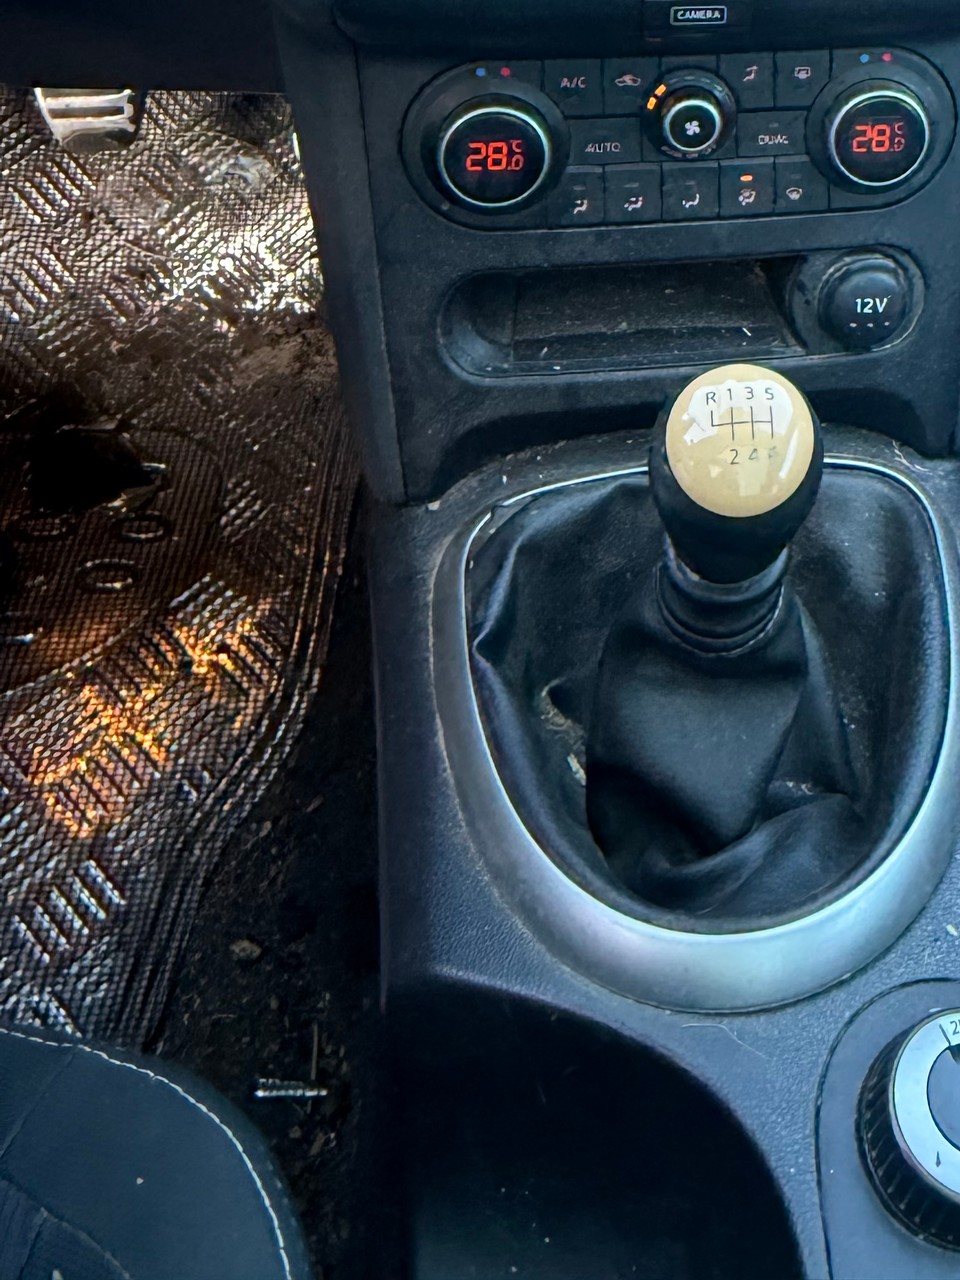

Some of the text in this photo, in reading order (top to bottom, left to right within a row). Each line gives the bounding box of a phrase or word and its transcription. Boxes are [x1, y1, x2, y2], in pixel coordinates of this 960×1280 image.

[676, 9, 721, 20] CAMERA
[560, 76, 587, 89] A/C
[584, 141, 621, 153] AUTO
[855, 296, 889, 315] 12V
[705, 391, 717, 405] R
[726, 387, 733, 401] 1
[744, 386, 755, 400] 3
[729, 448, 740, 465] 2
